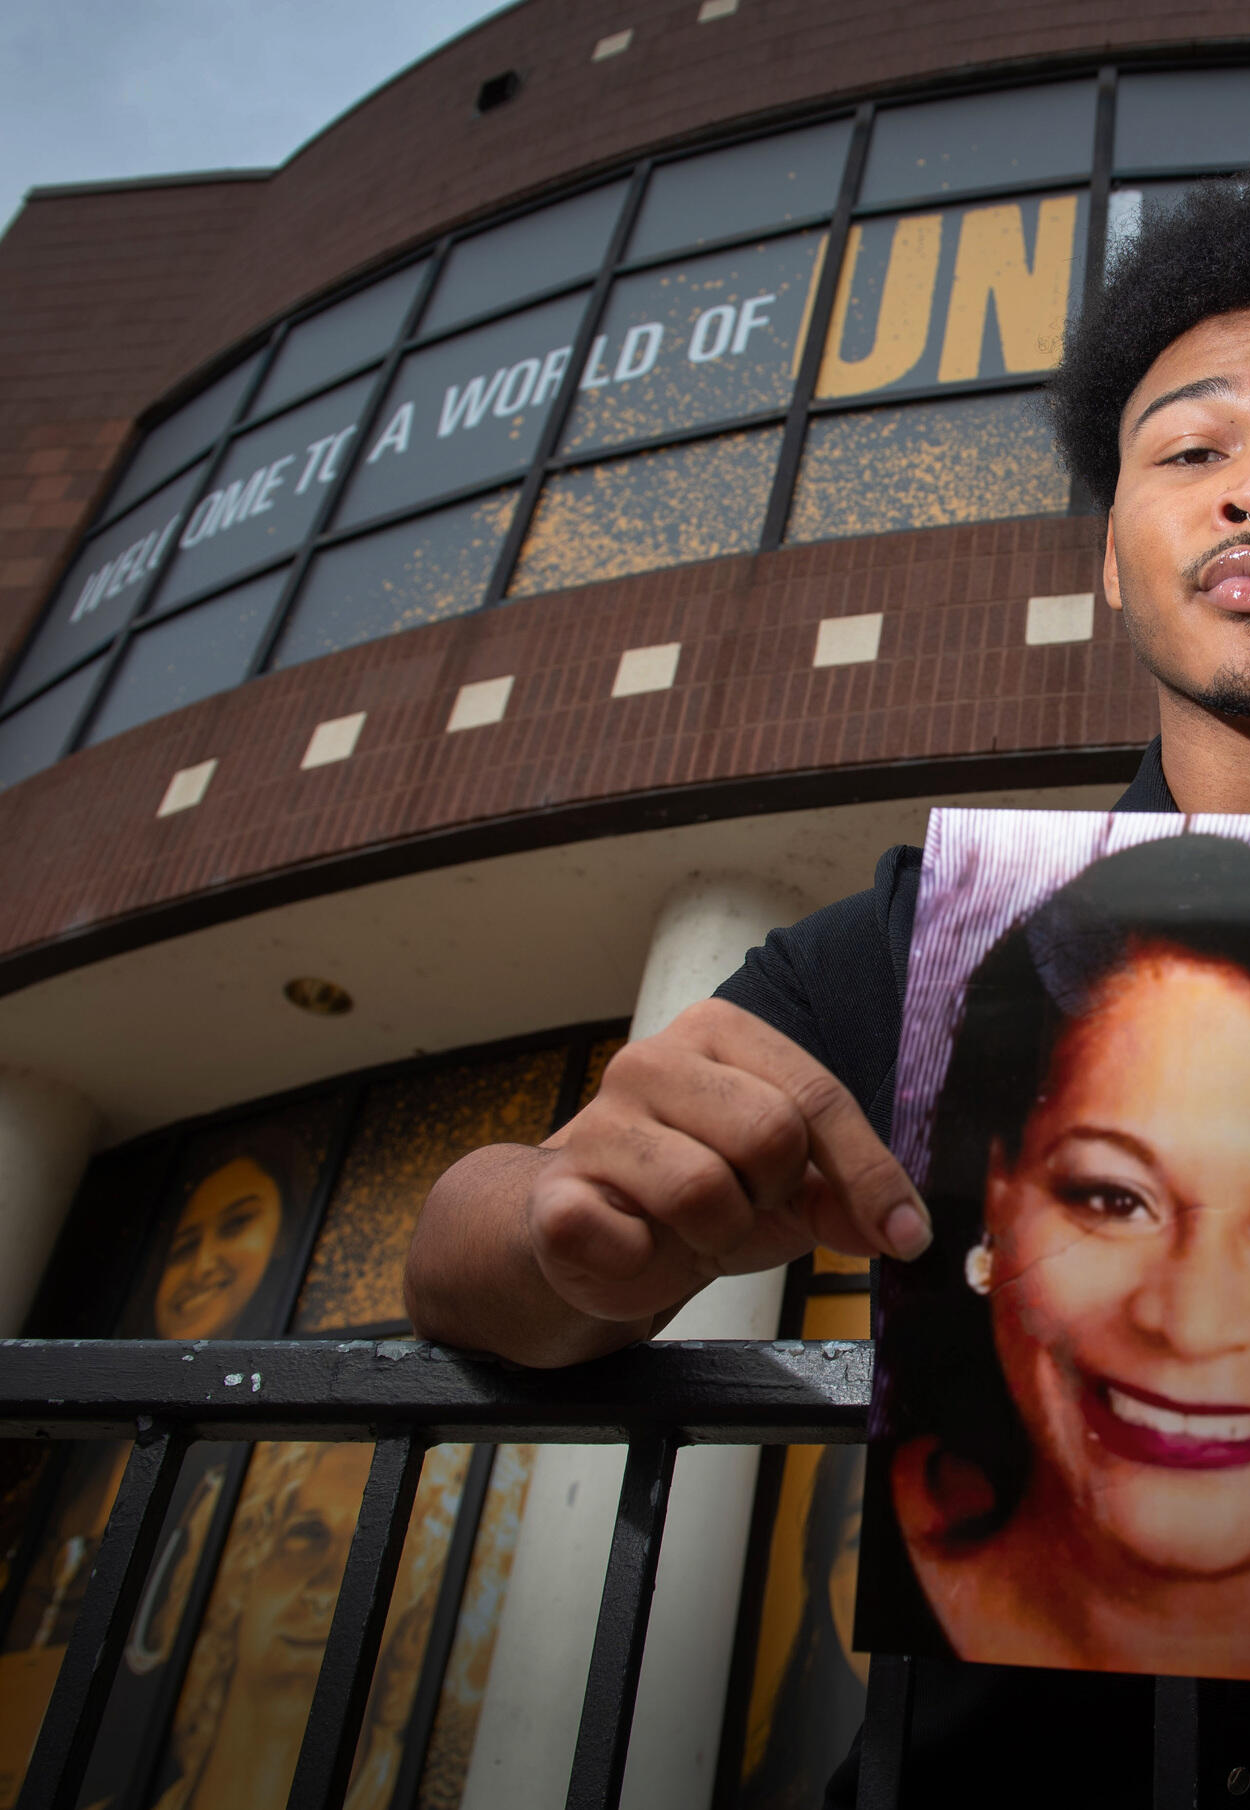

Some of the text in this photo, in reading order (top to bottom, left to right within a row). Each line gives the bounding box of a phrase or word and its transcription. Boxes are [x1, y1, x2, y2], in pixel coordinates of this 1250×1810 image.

[367, 400, 416, 464] A
[436, 321, 665, 439] WORLD
[688, 293, 777, 364] OF
